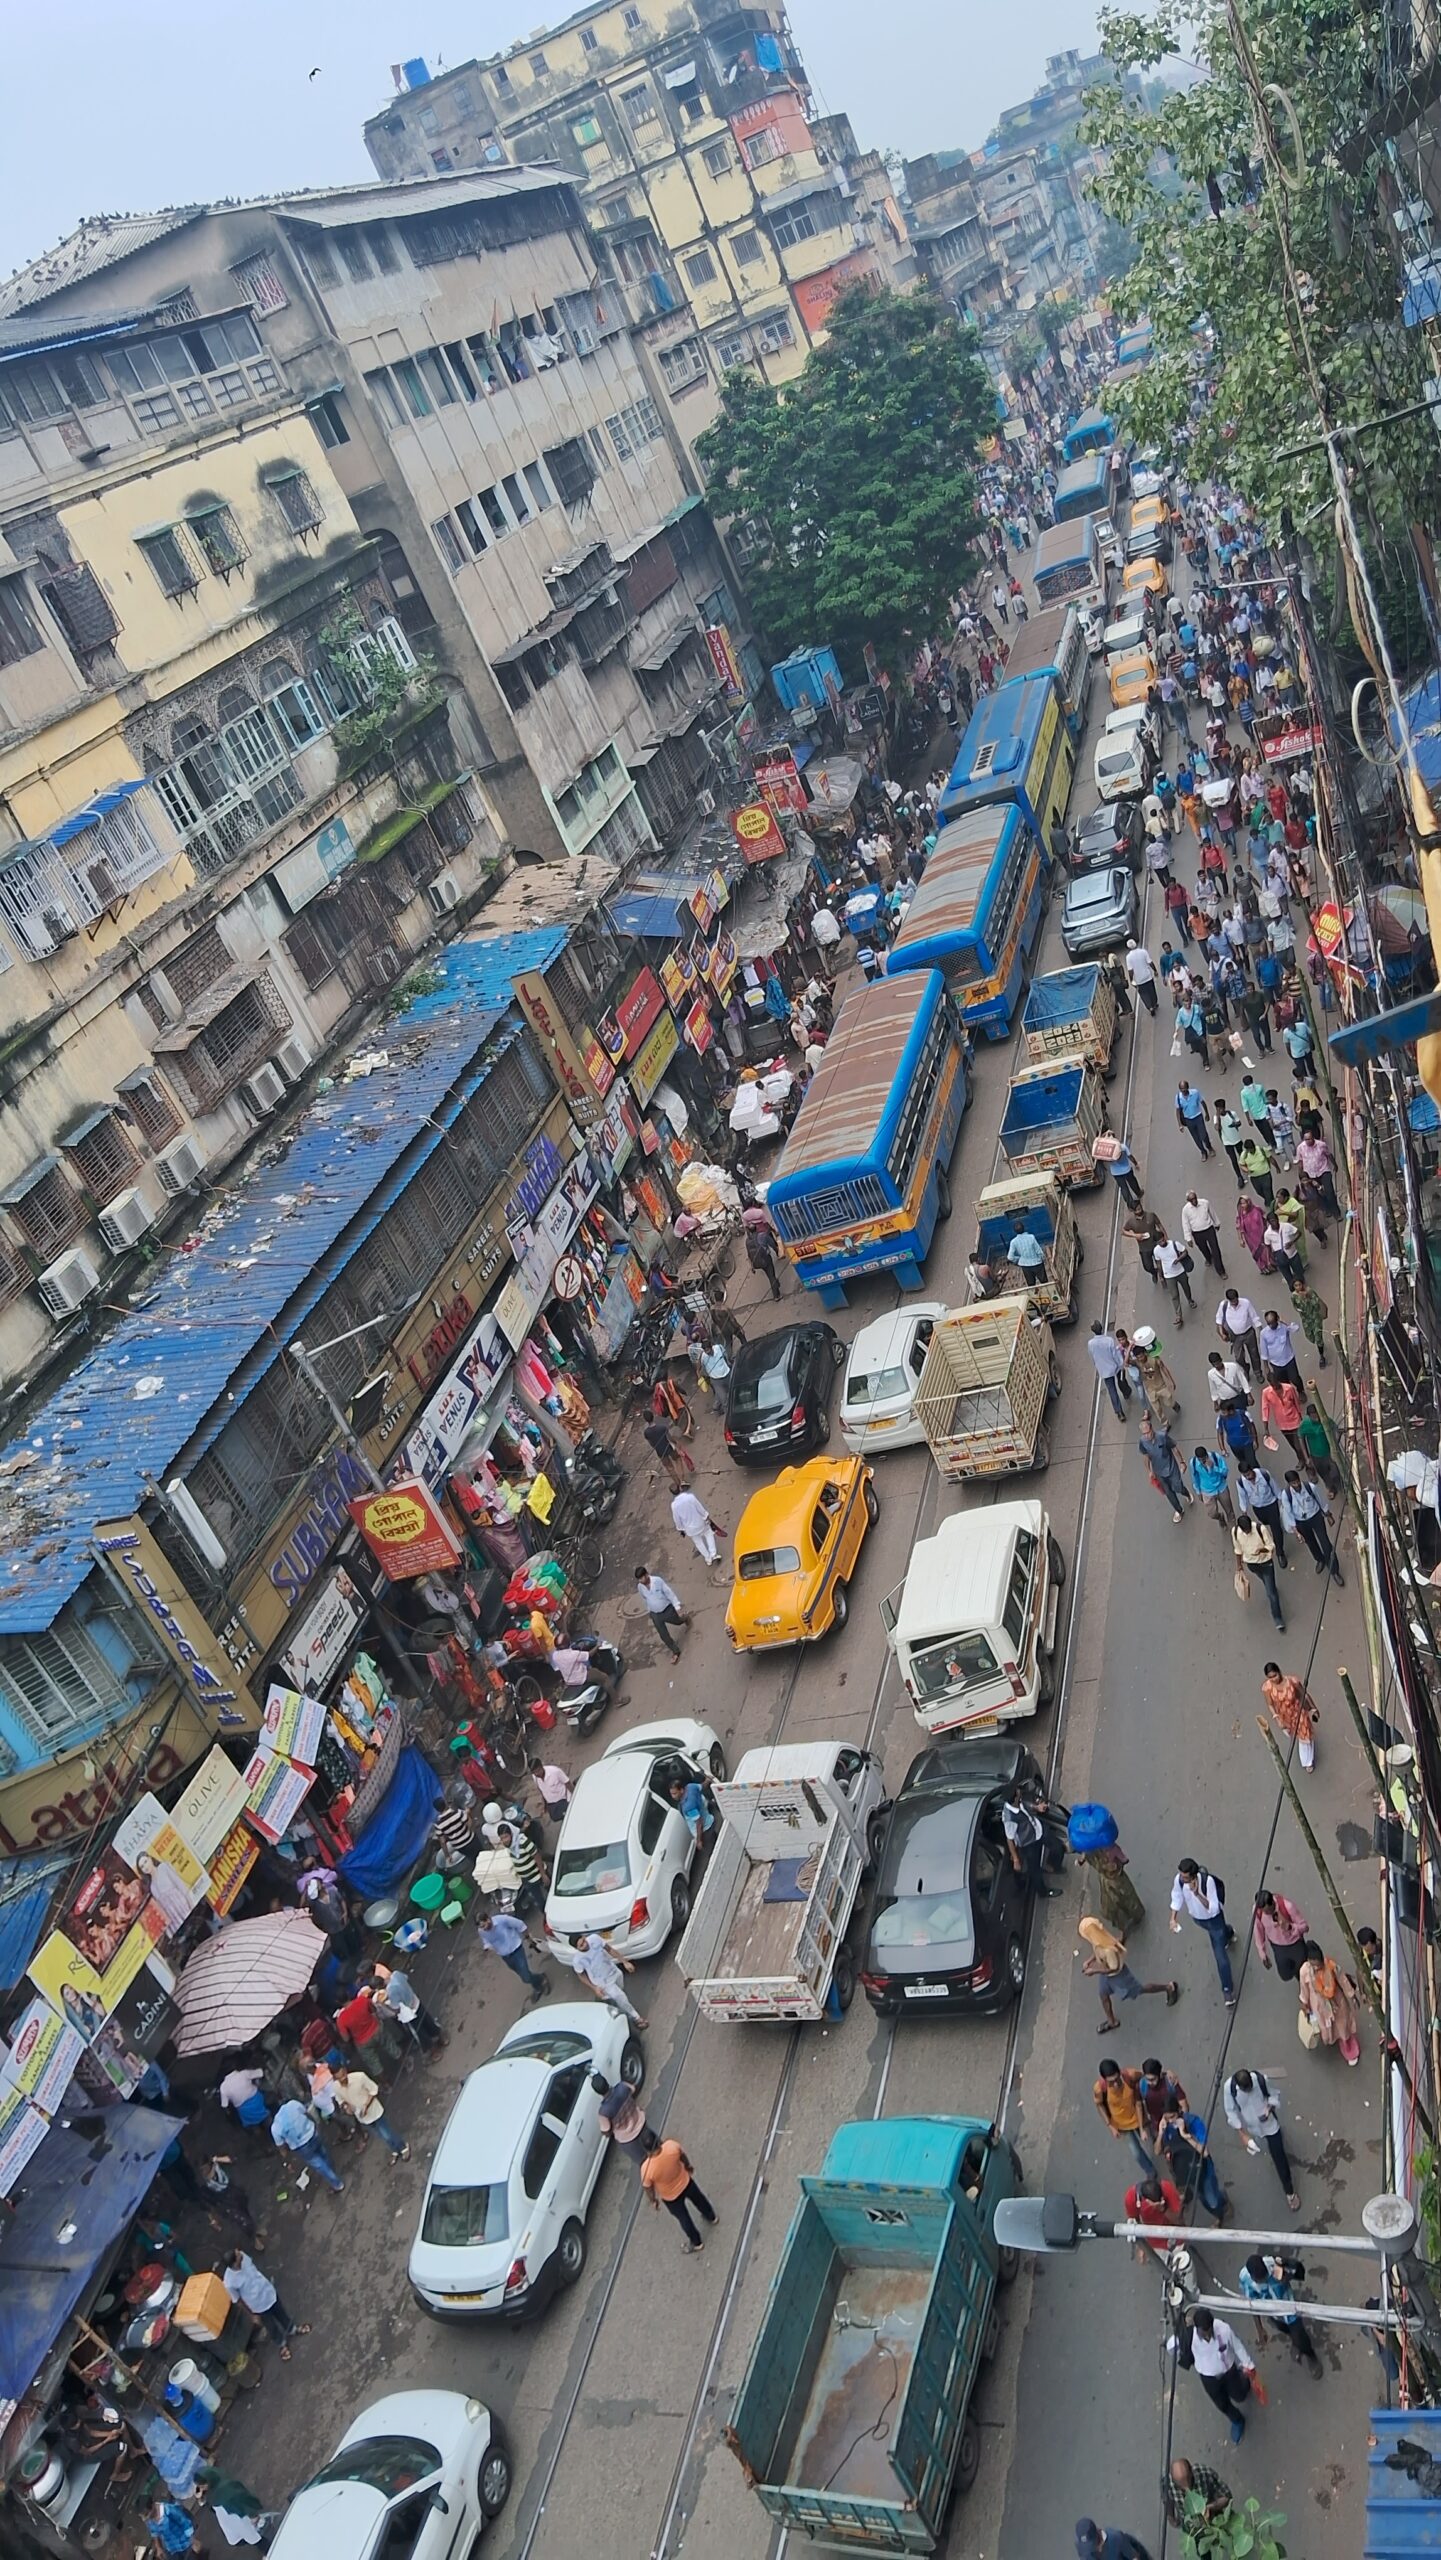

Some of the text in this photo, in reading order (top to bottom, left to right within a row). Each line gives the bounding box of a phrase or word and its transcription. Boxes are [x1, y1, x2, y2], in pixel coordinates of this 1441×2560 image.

[709, 632, 735, 690] Vandana
[1043, 1023, 1079, 1038] 2024
[1045, 1032, 1082, 1049] 2023
[549, 1203, 560, 1220] LUX
[550, 1206, 568, 1235] VENUS
[466, 1222, 494, 1263] SAREES
[796, 1243, 816, 1257] STOP
[480, 1248, 501, 1281] SUITS
[407, 1293, 474, 1391] Latika
[380, 1402, 405, 1440] SUITS
[438, 1391, 454, 1416] LUX
[438, 1393, 467, 1435] VENUS
[270, 1446, 371, 1608] SUBHAM
[372, 1510, 418, 1528] গোপাল
[373, 1502, 401, 1516] প্রিয়
[122, 1552, 223, 1690] SUBHAM
[217, 1604, 248, 1649] REES
[311, 1600, 345, 1659] Speed
[227, 1645, 239, 1659] &
[0, 1743, 186, 1853] Latika
[188, 1772, 220, 1818] OLIVE
[121, 1811, 158, 1857] BHAVYA
[206, 1824, 251, 1904] MANISHA
[134, 1992, 167, 2042] CADINI
[20, 2017, 53, 2082] COTTON PRINTED
[29, 2057, 44, 2083] FANCY
